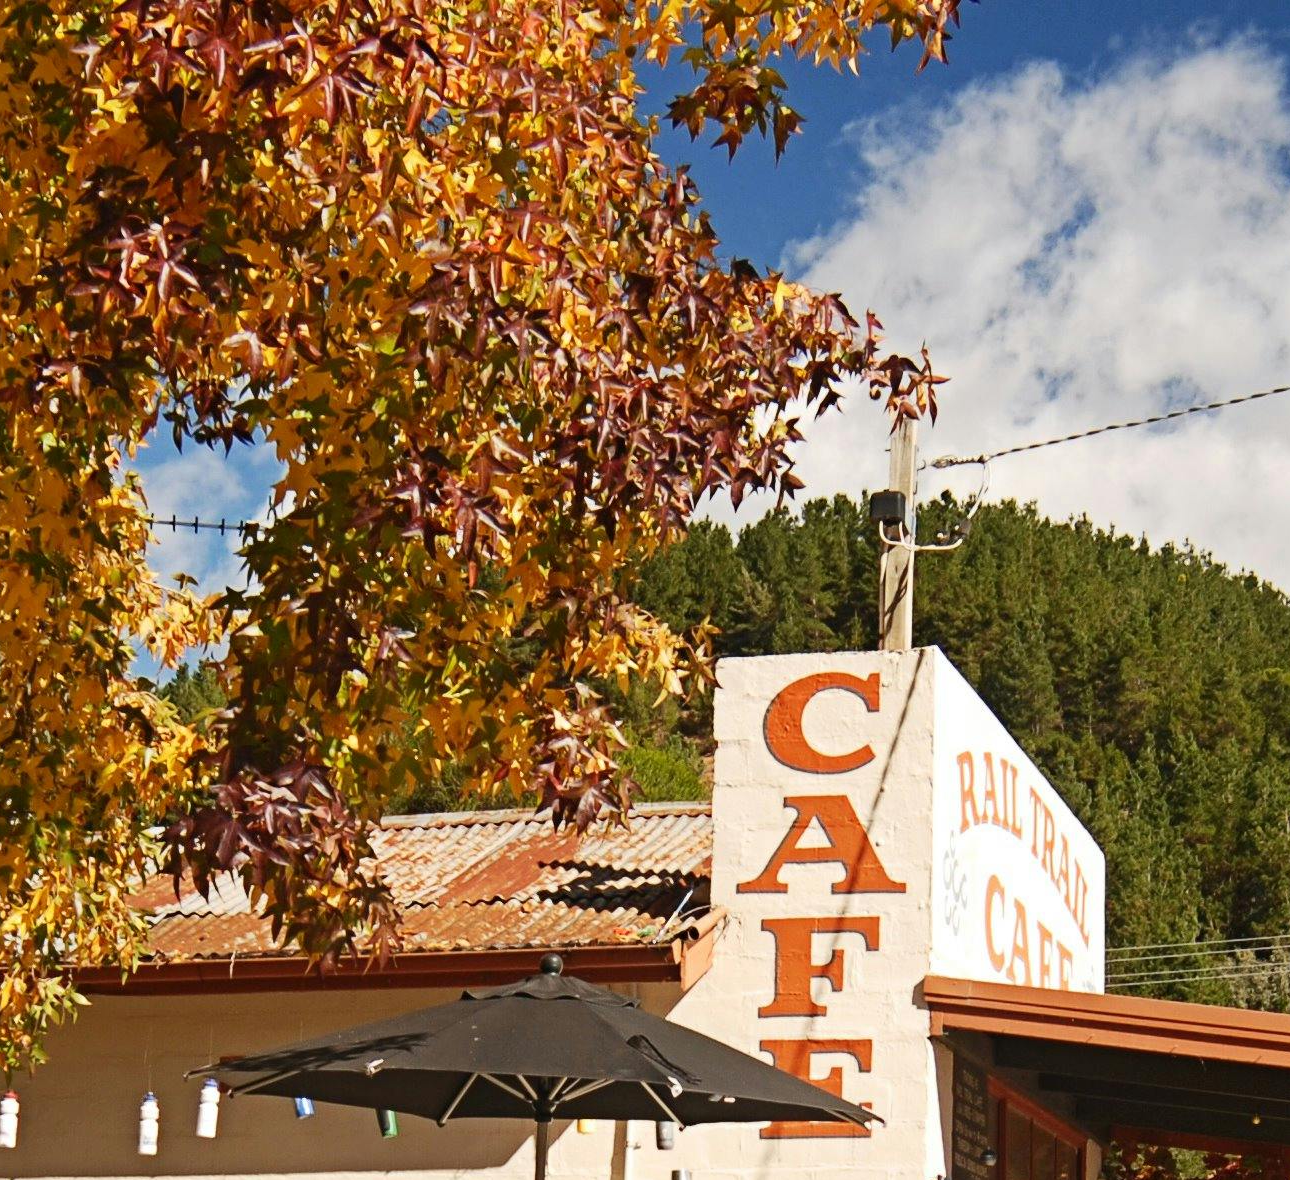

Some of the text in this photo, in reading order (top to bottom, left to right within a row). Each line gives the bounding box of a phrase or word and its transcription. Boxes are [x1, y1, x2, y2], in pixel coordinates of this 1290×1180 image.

[736, 671, 907, 1140] CAFE
[956, 750, 1090, 951] RAIL TRAIL
